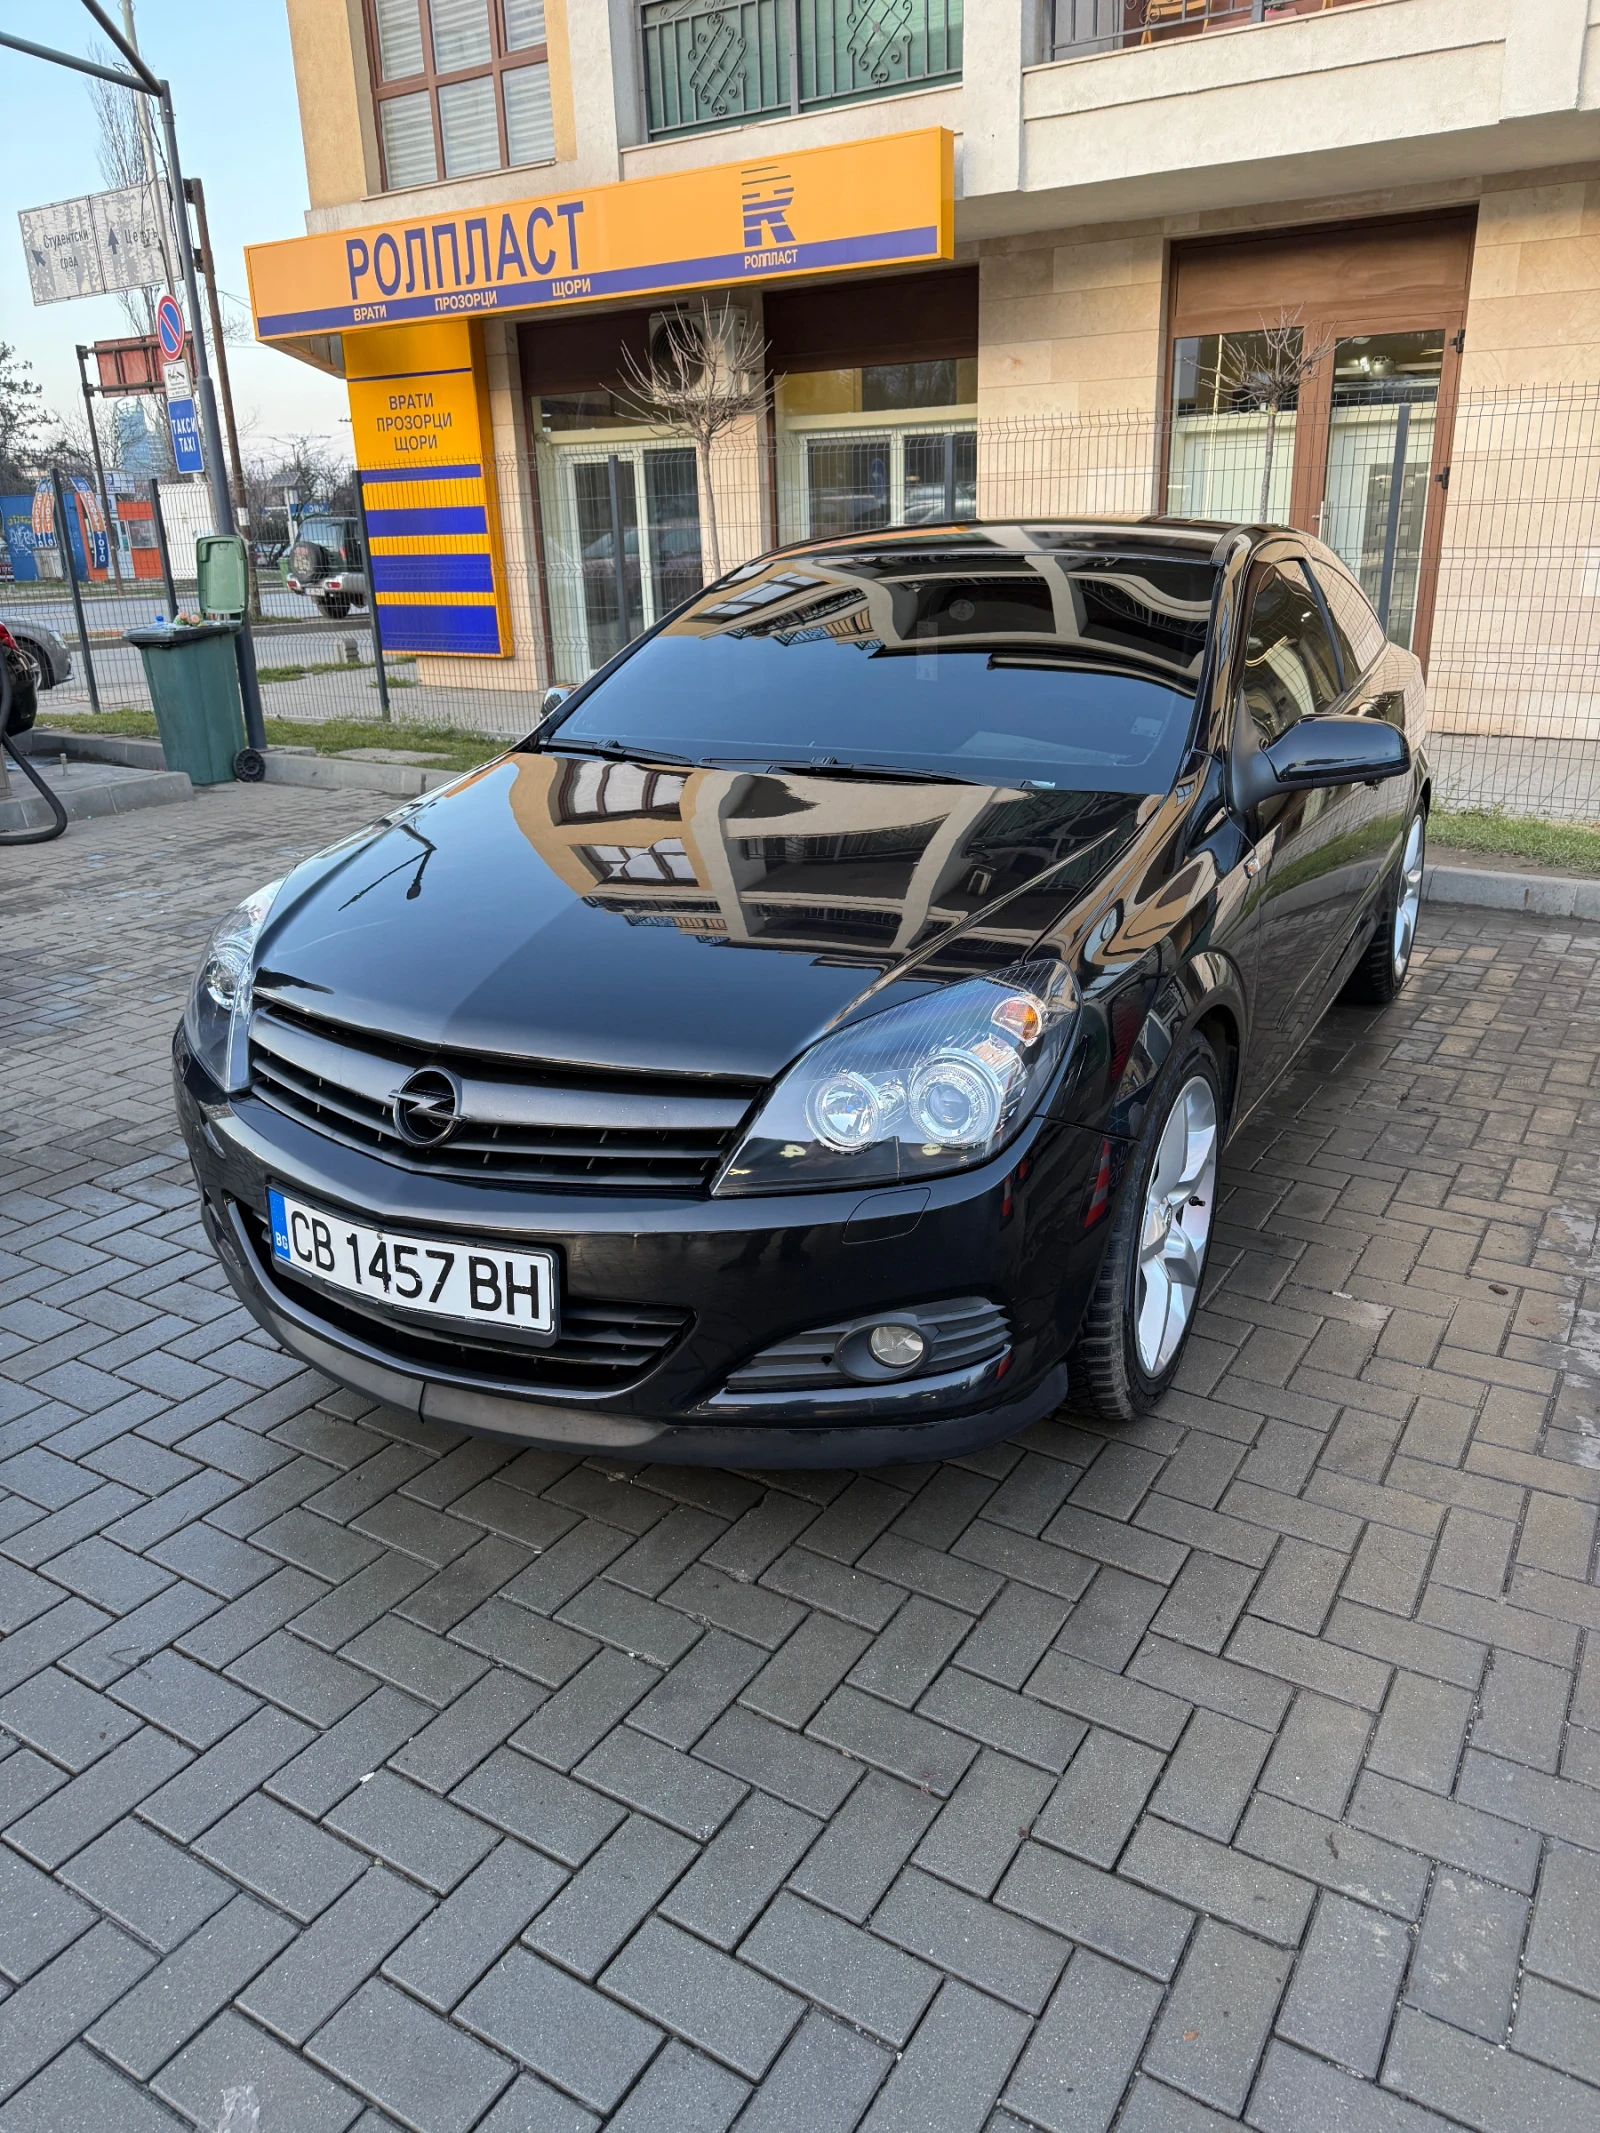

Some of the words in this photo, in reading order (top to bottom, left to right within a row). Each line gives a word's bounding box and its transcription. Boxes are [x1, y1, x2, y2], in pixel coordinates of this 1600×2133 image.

[43, 229, 89, 251] Студентски
[346, 200, 584, 300] РОЛПЛАСТ
[744, 249, 798, 269] РОЛПЛАСТ
[353, 305, 387, 321] ВРАТИ
[434, 290, 498, 312] ПРОЗОРЦИ
[552, 278, 591, 298] ЩОРИ
[389, 393, 434, 410] ВРАТИ
[171, 417, 197, 434] ТАКСИ
[376, 412, 452, 432] ПРОЗОРЦИ
[178, 437, 197, 453] TAXI
[394, 434, 438, 453] ЩОРИ
[97, 531, 106, 562] ТОТО
[275, 1232, 289, 1250] BG
[291, 1210, 335, 1272] CB
[346, 1233, 455, 1303] 1457
[468, 1255, 540, 1320] BH
